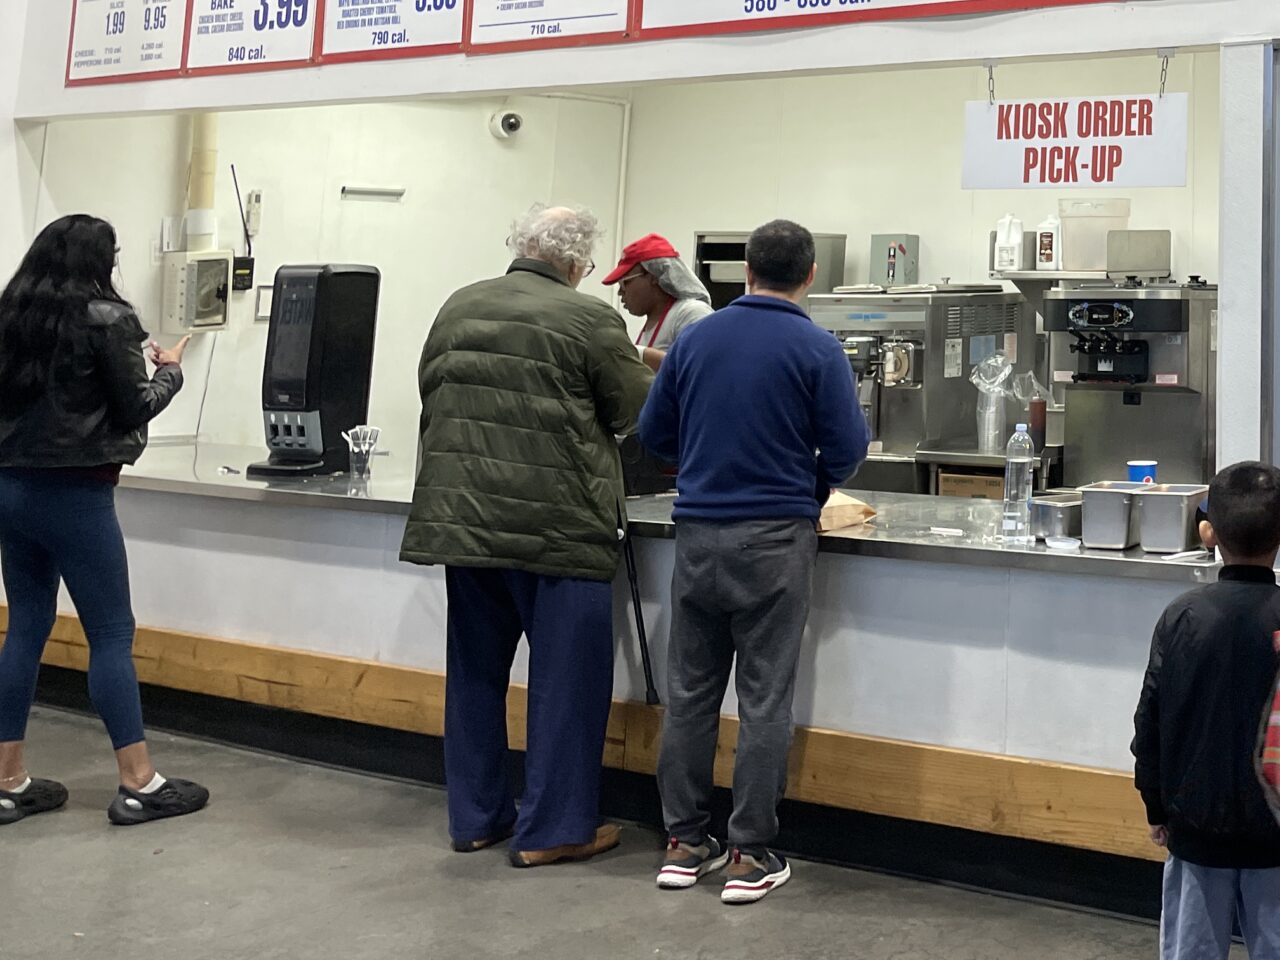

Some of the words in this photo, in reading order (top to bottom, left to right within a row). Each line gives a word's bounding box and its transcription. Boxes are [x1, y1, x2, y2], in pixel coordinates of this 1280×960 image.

[106, 11, 126, 35] 1.99
[144, 6, 167, 31] 9.95
[530, 24, 546, 35] 710
[547, 23, 562, 34] cal.
[372, 31, 389, 45] 790
[391, 29, 410, 43] cal.
[228, 46, 246, 62] 840
[248, 44, 266, 60] cal.
[997, 102, 1069, 140] KIOSK
[1077, 99, 1154, 138] ORDER
[1023, 145, 1123, 184] PICK-UP
